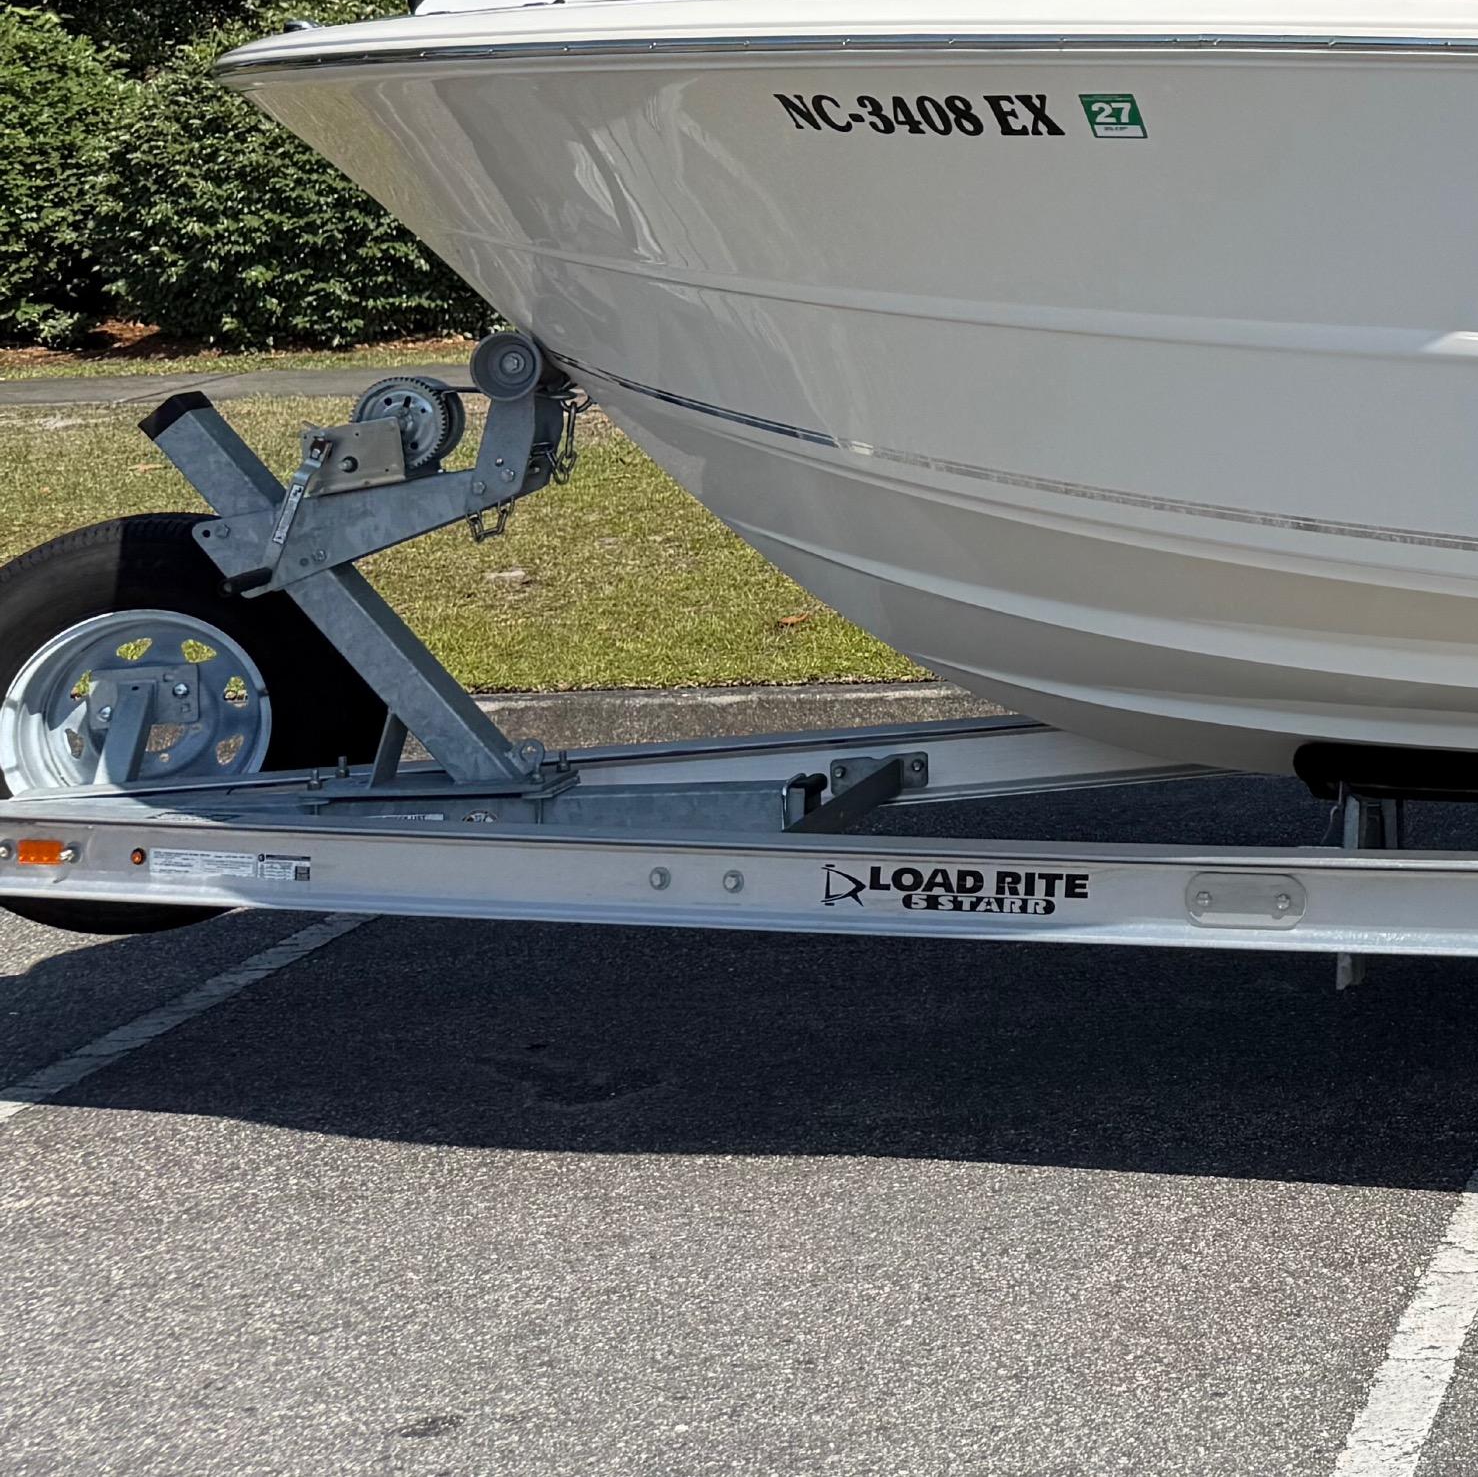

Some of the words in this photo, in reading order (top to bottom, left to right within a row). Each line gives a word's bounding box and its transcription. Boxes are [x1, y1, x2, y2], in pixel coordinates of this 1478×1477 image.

[773, 93, 984, 136] NC-3408
[983, 94, 1066, 136] EX
[1091, 101, 1132, 123] 27
[869, 865, 984, 895] LOAD
[995, 870, 1090, 899] RITE
[910, 895, 928, 909] 5
[938, 896, 1048, 915] STARR
